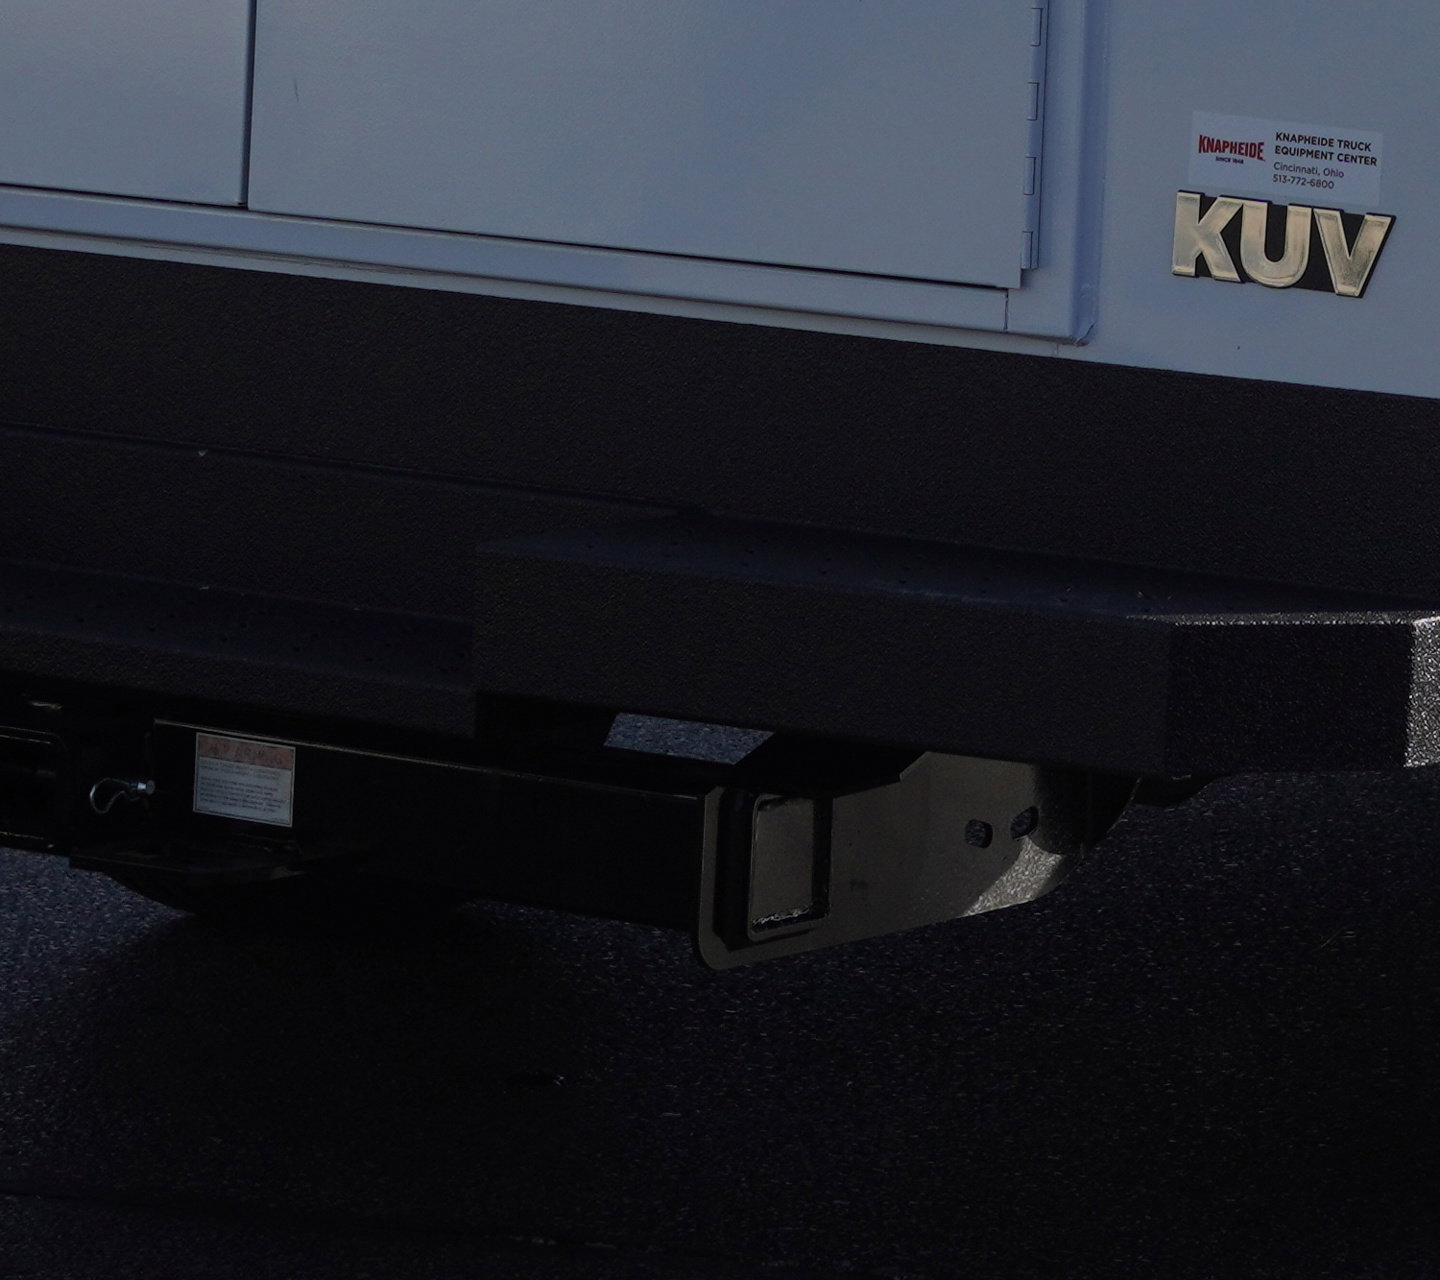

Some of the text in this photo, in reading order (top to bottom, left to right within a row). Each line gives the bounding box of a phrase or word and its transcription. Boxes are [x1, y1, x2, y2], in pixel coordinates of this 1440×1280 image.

[1198, 134, 1265, 159] KNAPHEIDE
[1276, 132, 1371, 152] KNAPHEIDE TRUCK
[1274, 145, 1377, 166] EQUIPMENT CENTER
[1273, 161, 1344, 178] Cincinnati, Ohio
[1273, 174, 1334, 189] 513-772-6800
[1172, 189, 1396, 298] KUV
